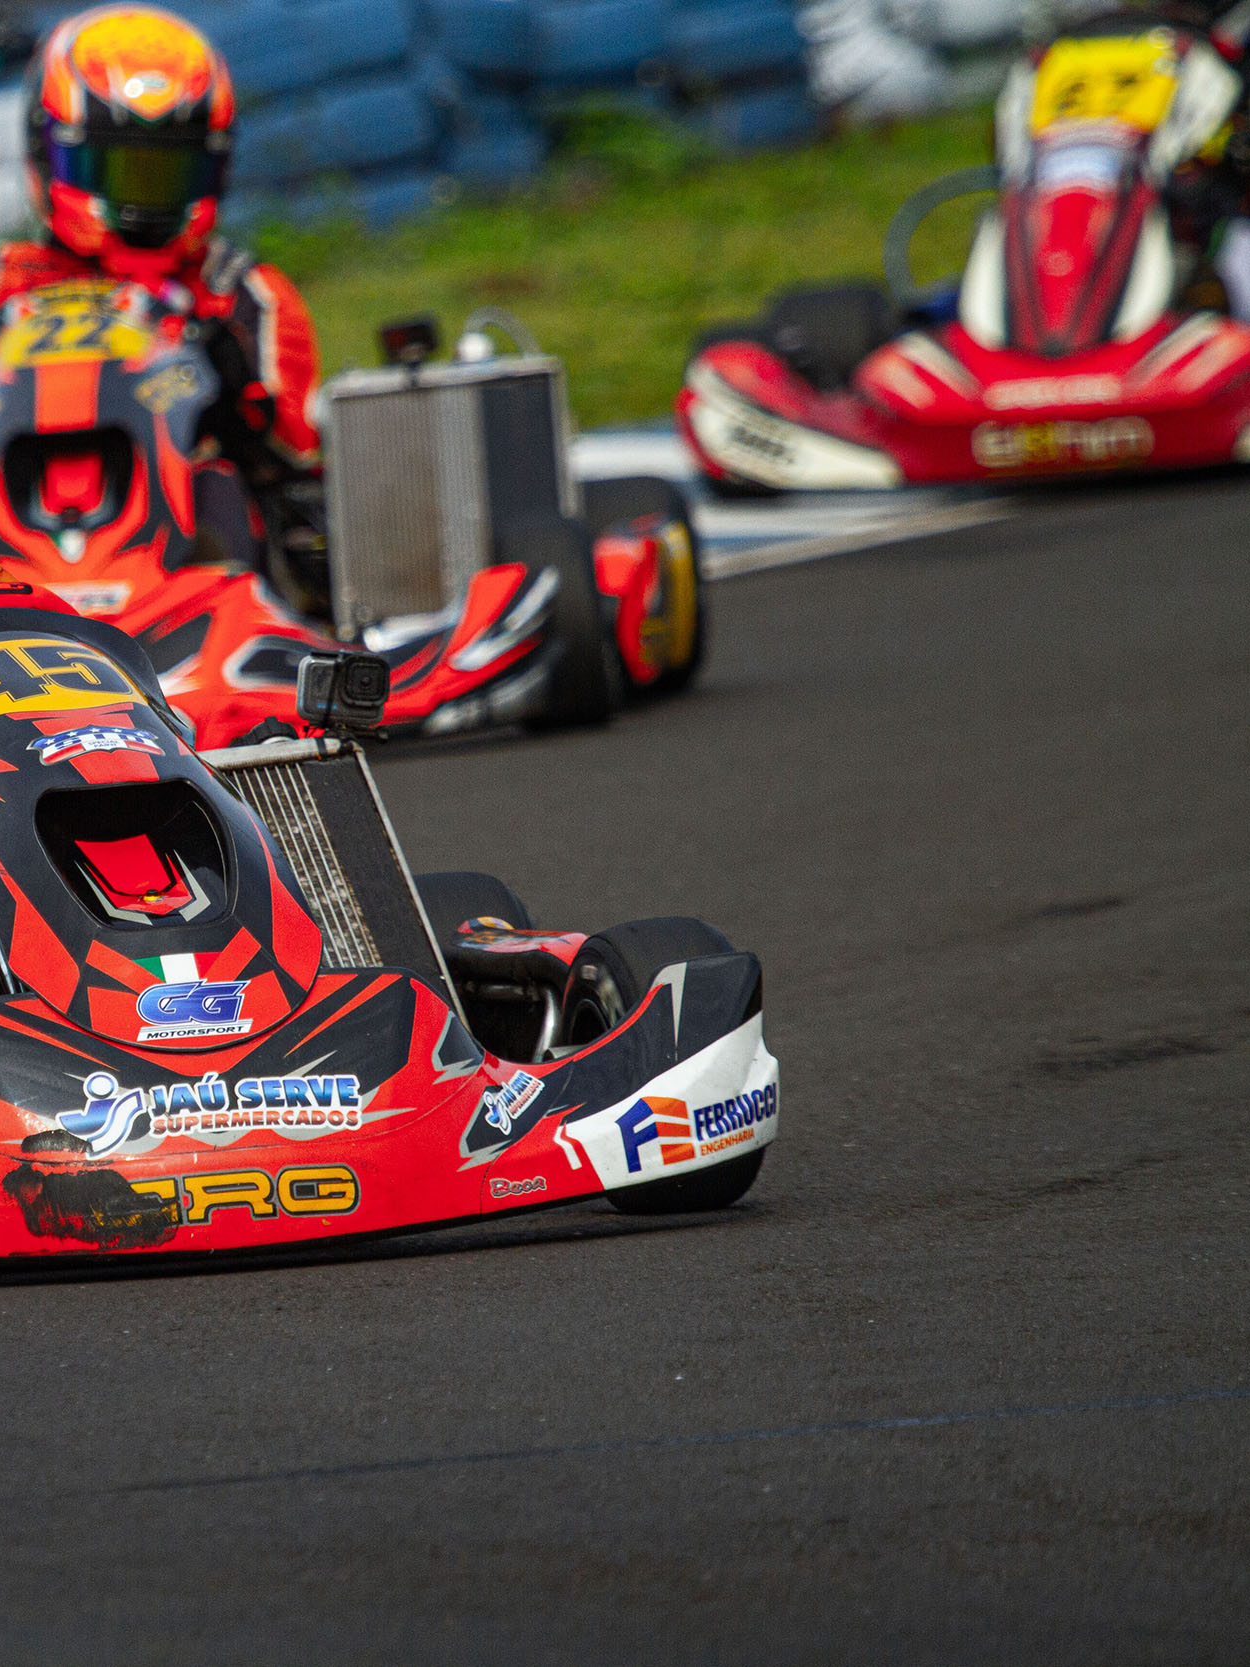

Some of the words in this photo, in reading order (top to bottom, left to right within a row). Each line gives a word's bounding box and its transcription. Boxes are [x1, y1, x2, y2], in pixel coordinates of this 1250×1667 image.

[29, 313, 114, 354] 22
[136, 979, 250, 1025] GG
[146, 1025, 244, 1040] MOTORSPORT
[152, 1074, 228, 1117] JAÚ
[238, 1077, 361, 1109] SERVE
[694, 1082, 777, 1141] FERRUCCI
[153, 1109, 360, 1135] SUPERMERCADOS
[700, 1128, 756, 1157] ENGENHARIA
